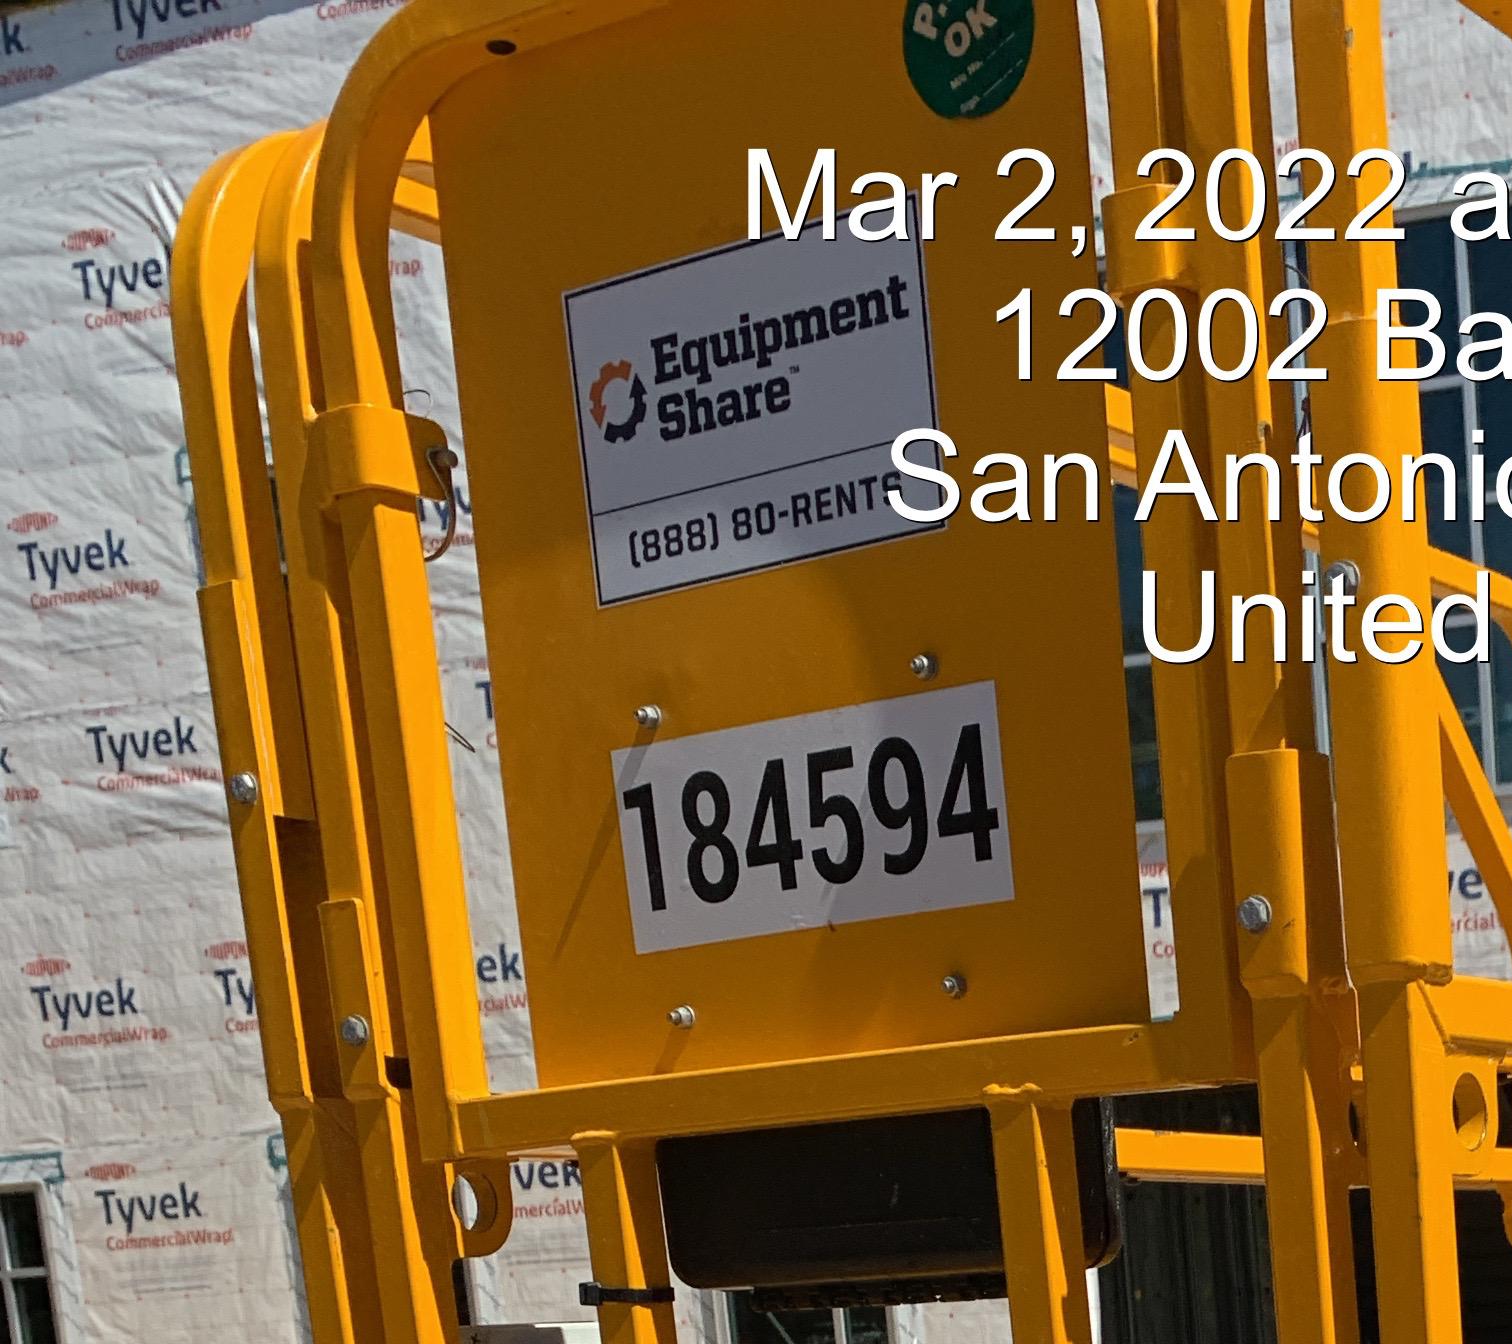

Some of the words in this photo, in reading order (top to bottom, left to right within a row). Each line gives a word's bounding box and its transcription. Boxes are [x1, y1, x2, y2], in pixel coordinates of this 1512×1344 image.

[115, 23, 254, 62] CommercialWrap
[944, 0, 998, 57] OK
[72, 257, 171, 307] Tyve
[650, 275, 910, 385] Equipment
[656, 375, 792, 443] Share
[18, 528, 129, 589] Tyvek
[628, 512, 721, 568] (888)
[30, 579, 160, 610] CommercialWrap
[86, 716, 197, 772] Tyvek
[622, 723, 999, 911] 184594
[30, 977, 138, 1031] Tyvek
[42, 1026, 169, 1049] CommercialWrap
[95, 1182, 203, 1234] Tyvek
[106, 1228, 234, 1251] CommercialWrap
